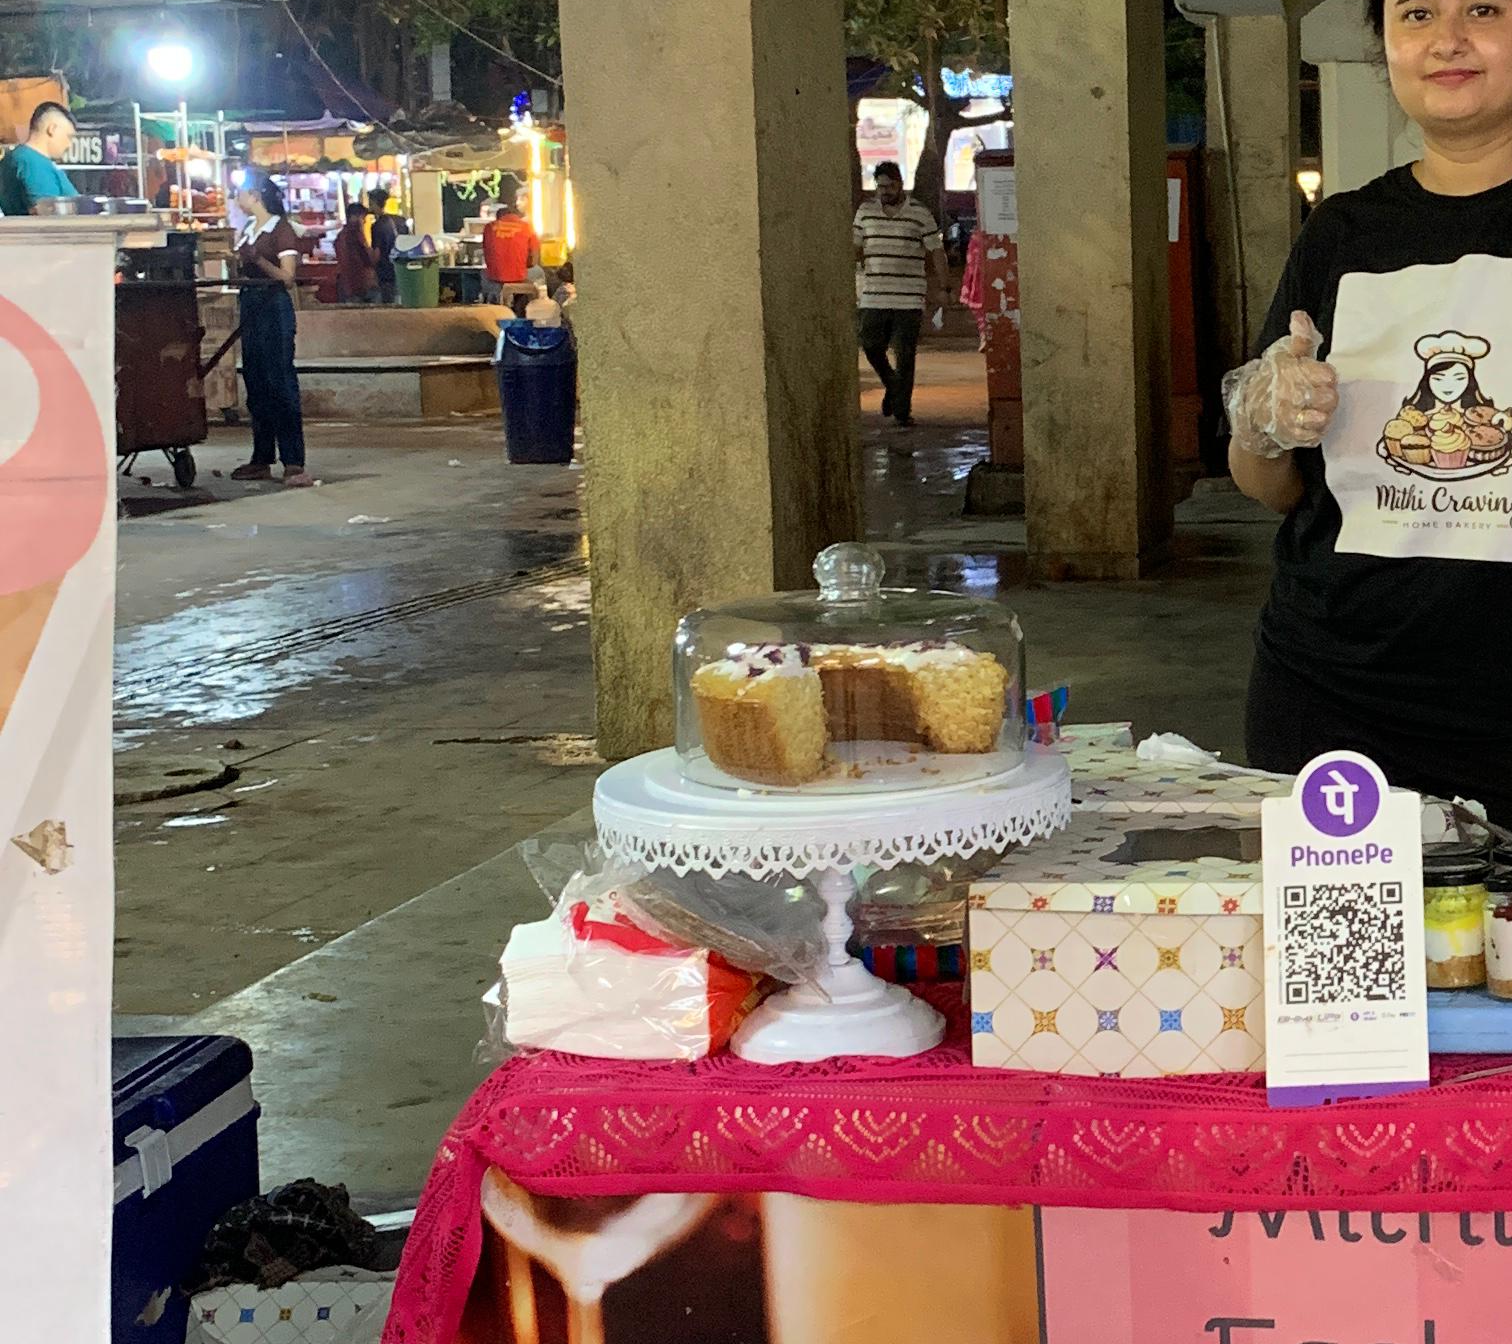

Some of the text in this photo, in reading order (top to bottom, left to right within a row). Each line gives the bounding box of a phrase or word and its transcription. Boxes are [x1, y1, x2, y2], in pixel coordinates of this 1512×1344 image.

[1376, 484, 1427, 512] Mithi
[1402, 519, 1492, 529] HOME BAKERY
[1290, 843, 1394, 867] PhonePe
